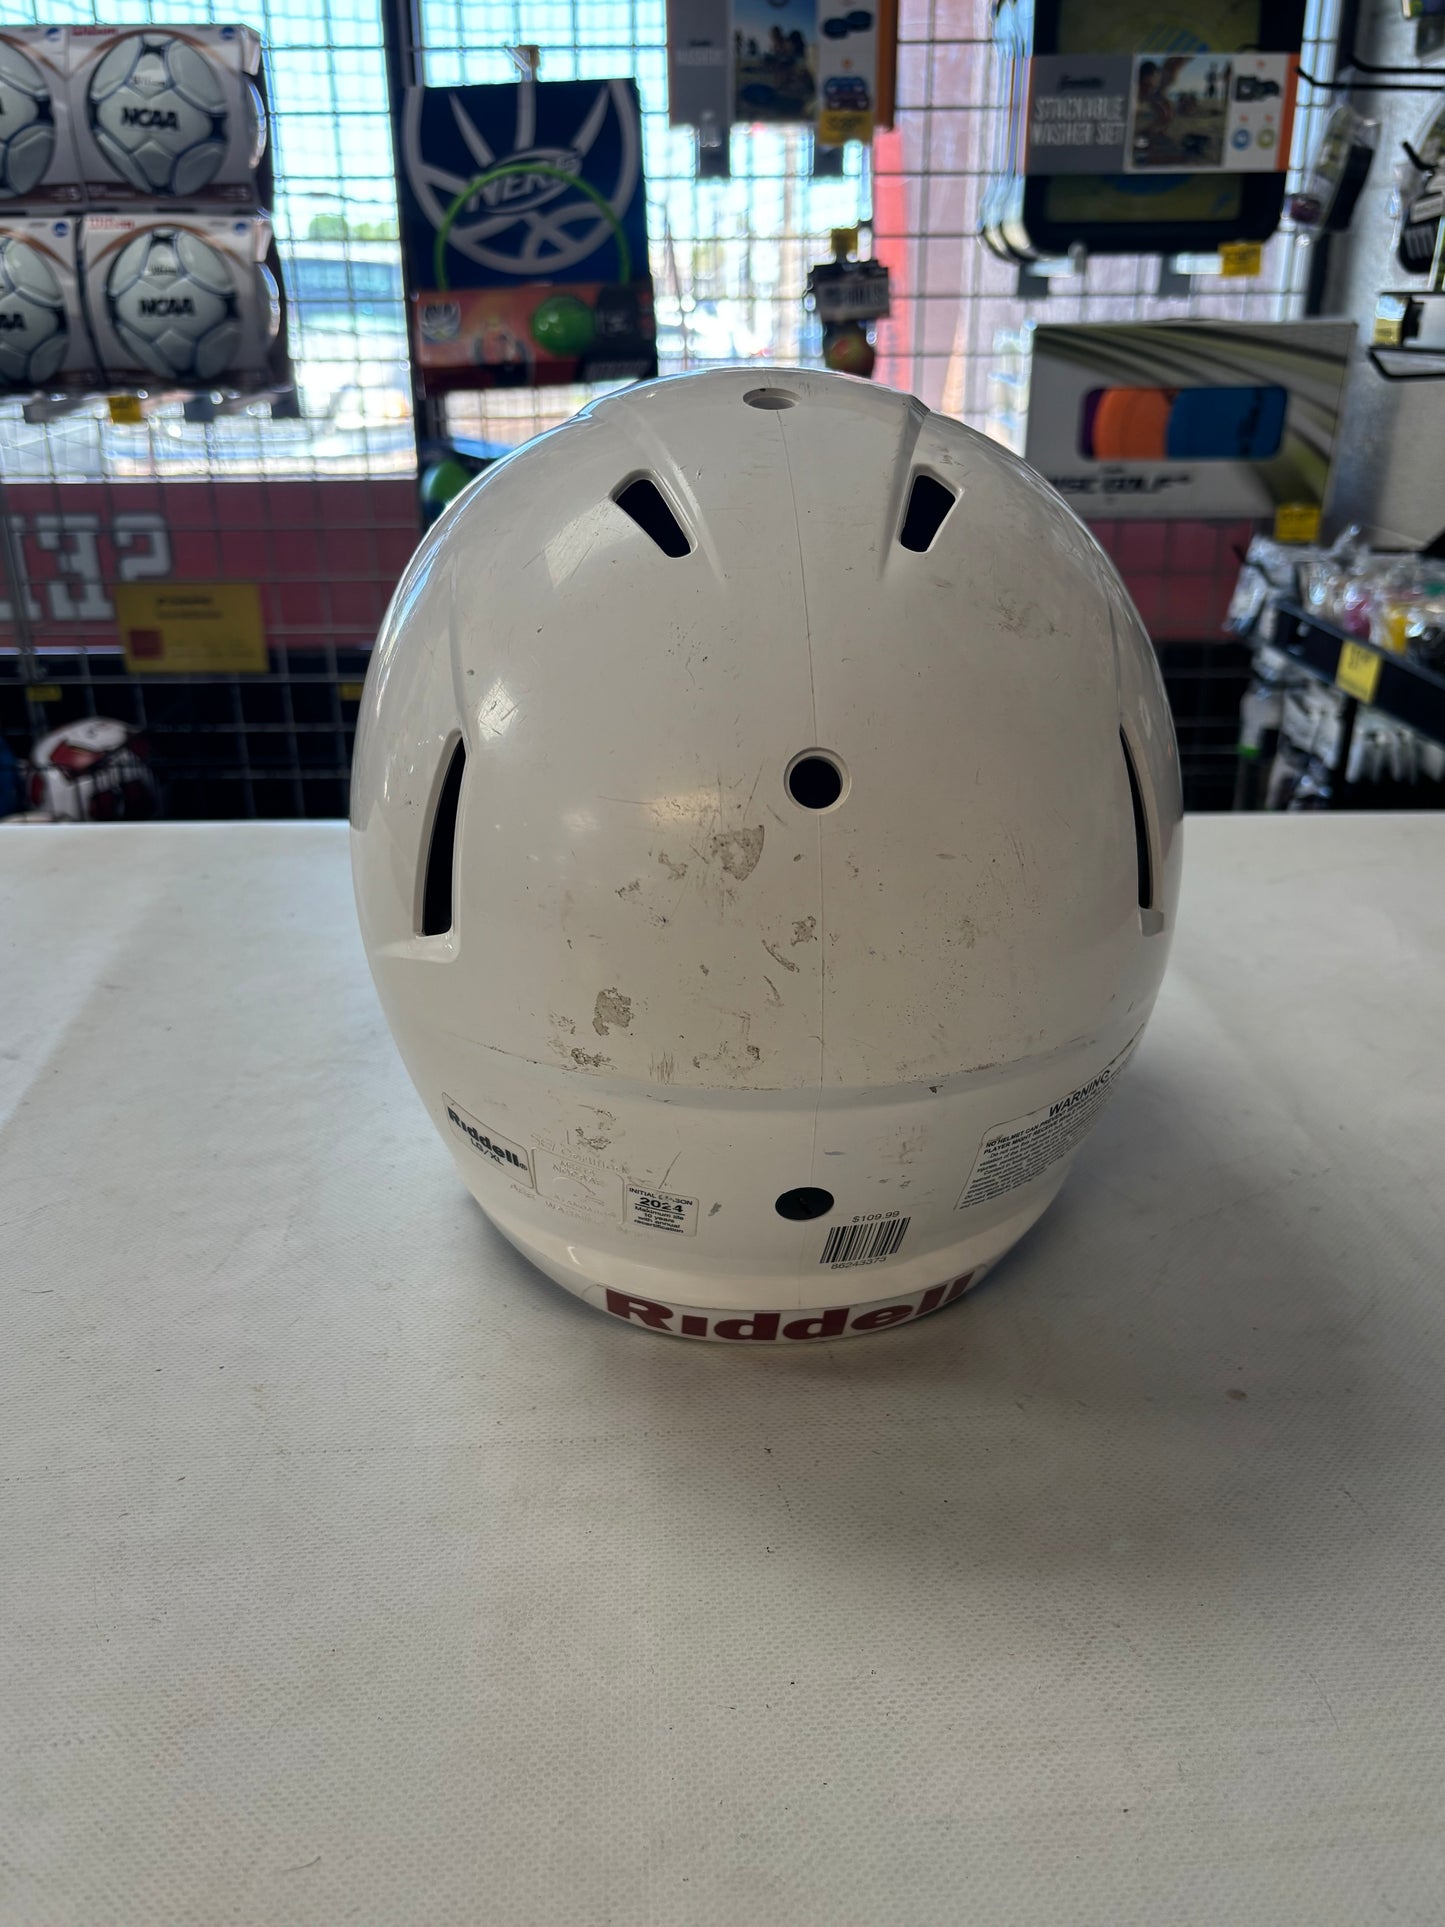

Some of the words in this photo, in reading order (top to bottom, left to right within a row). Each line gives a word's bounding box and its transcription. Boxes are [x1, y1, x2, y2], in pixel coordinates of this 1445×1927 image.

[121, 106, 179, 130] NCAA
[1096, 122, 1125, 145] SET
[138, 296, 195, 317] NCAA
[1049, 1070, 1110, 1117] WARNING
[447, 1106, 521, 1168] Riddell
[629, 1187, 657, 1199] INITIAL
[634, 1205, 671, 1218] Maximum
[639, 1197, 684, 1213] 2024
[654, 1215, 675, 1224] years
[852, 1210, 900, 1223] $109.99
[605, 1270, 975, 1341] Riddell
